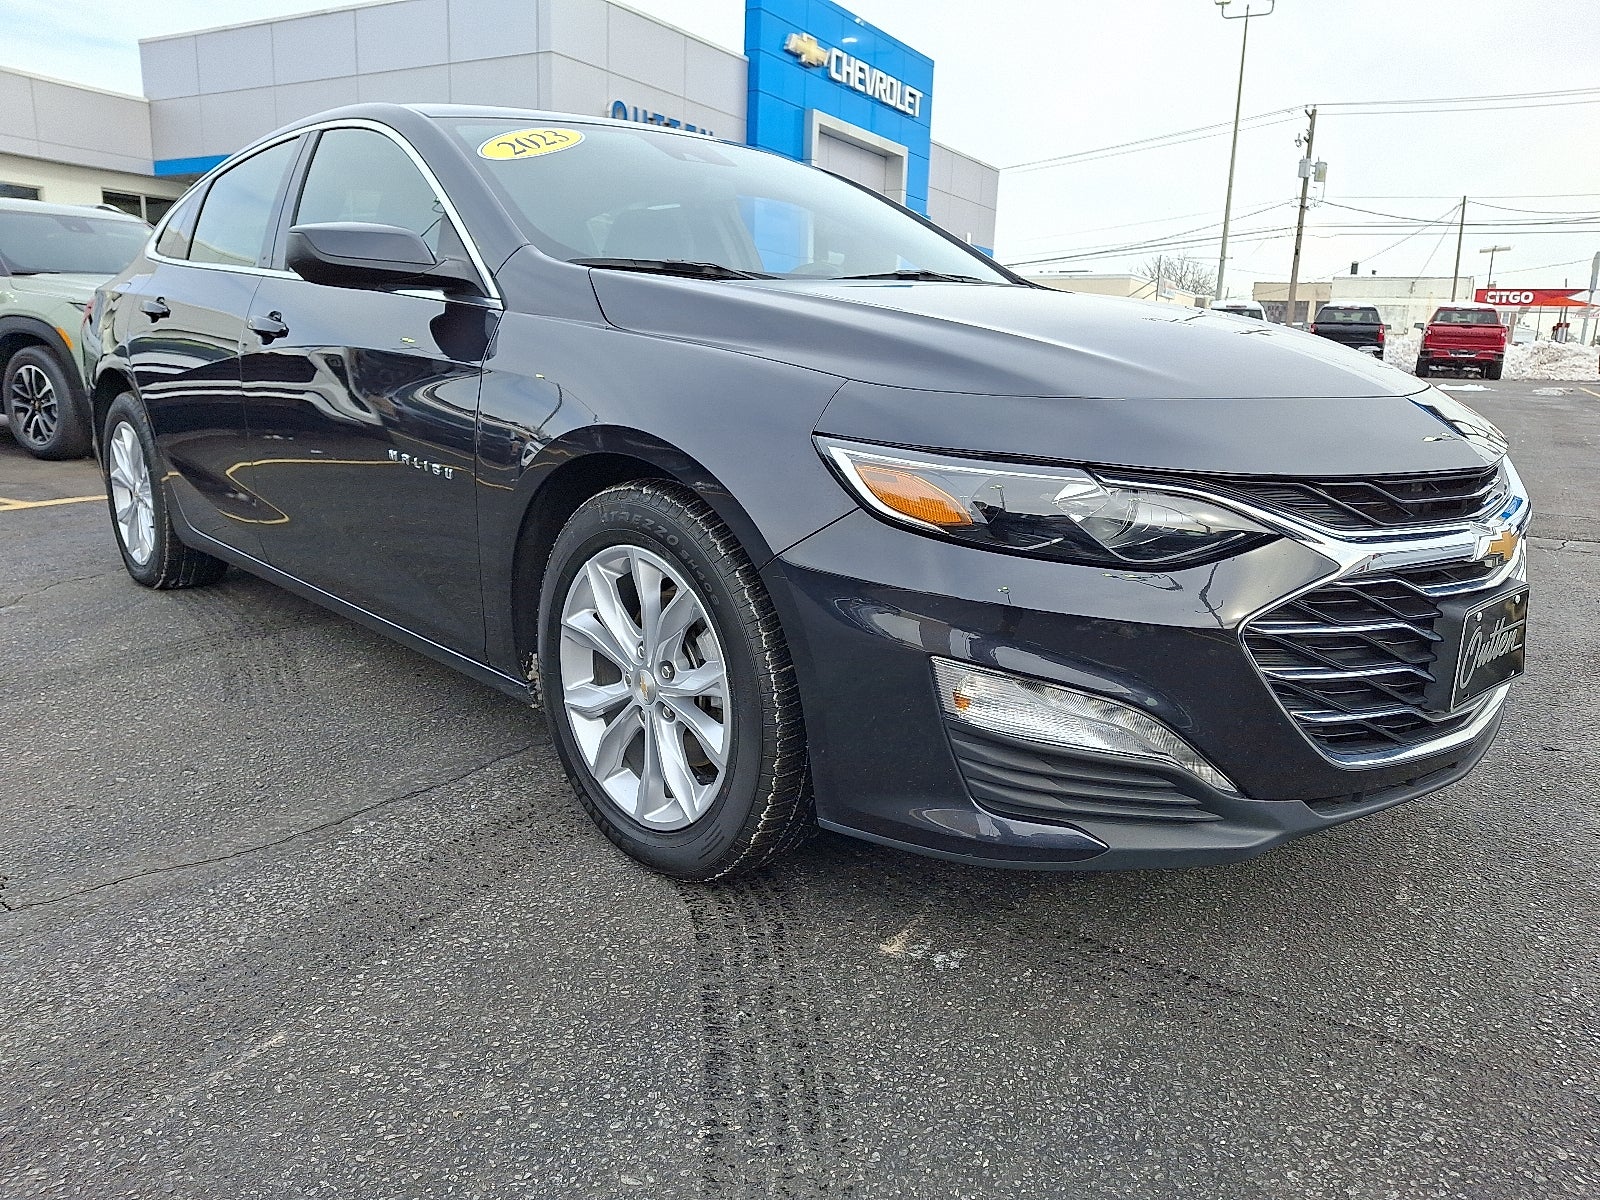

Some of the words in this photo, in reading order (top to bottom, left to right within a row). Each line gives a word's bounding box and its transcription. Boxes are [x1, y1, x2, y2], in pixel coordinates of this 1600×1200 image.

[829, 47, 923, 118] CHEVROLET
[610, 100, 713, 137] OUTT
[496, 130, 570, 155] 2023
[1486, 291, 1534, 304] CITGO
[388, 449, 453, 480] MALIBU
